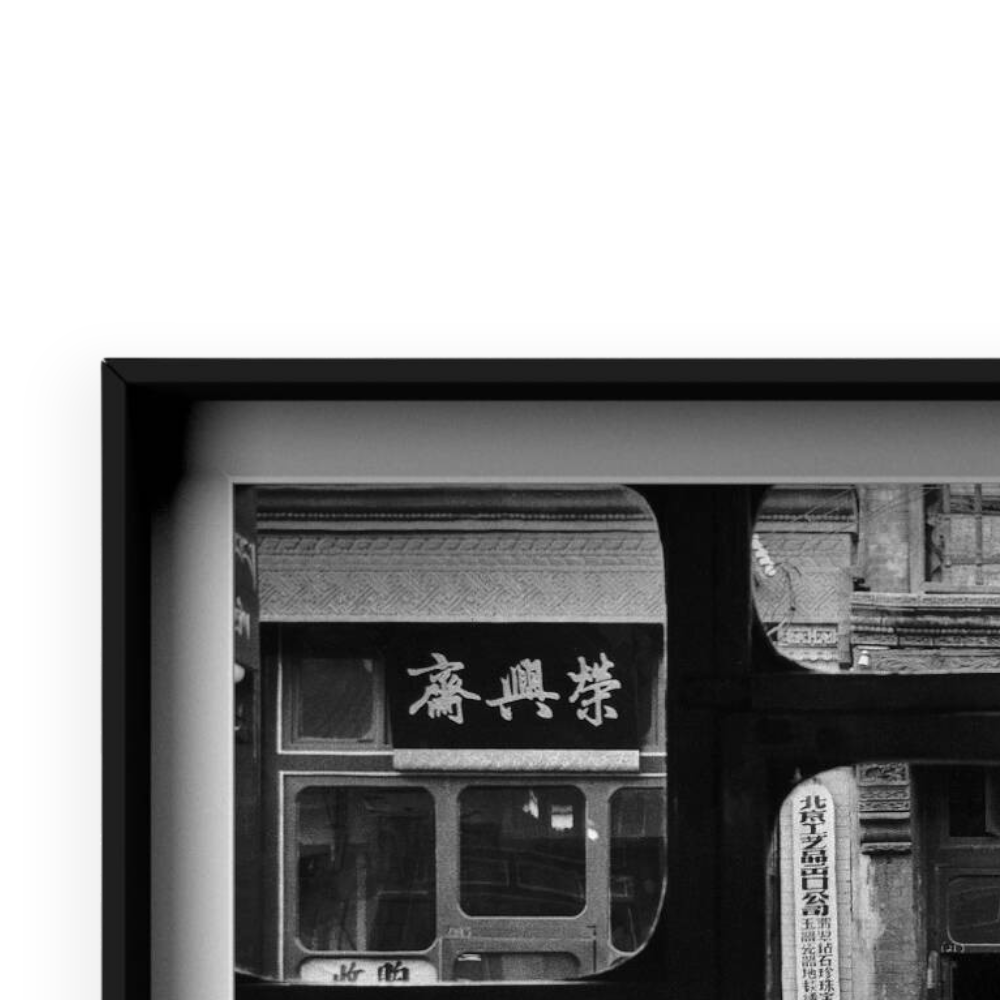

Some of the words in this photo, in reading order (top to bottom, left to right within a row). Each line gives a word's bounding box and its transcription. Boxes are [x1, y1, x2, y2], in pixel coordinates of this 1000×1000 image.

[799, 795, 830, 916] 北京工艺品出口公司
